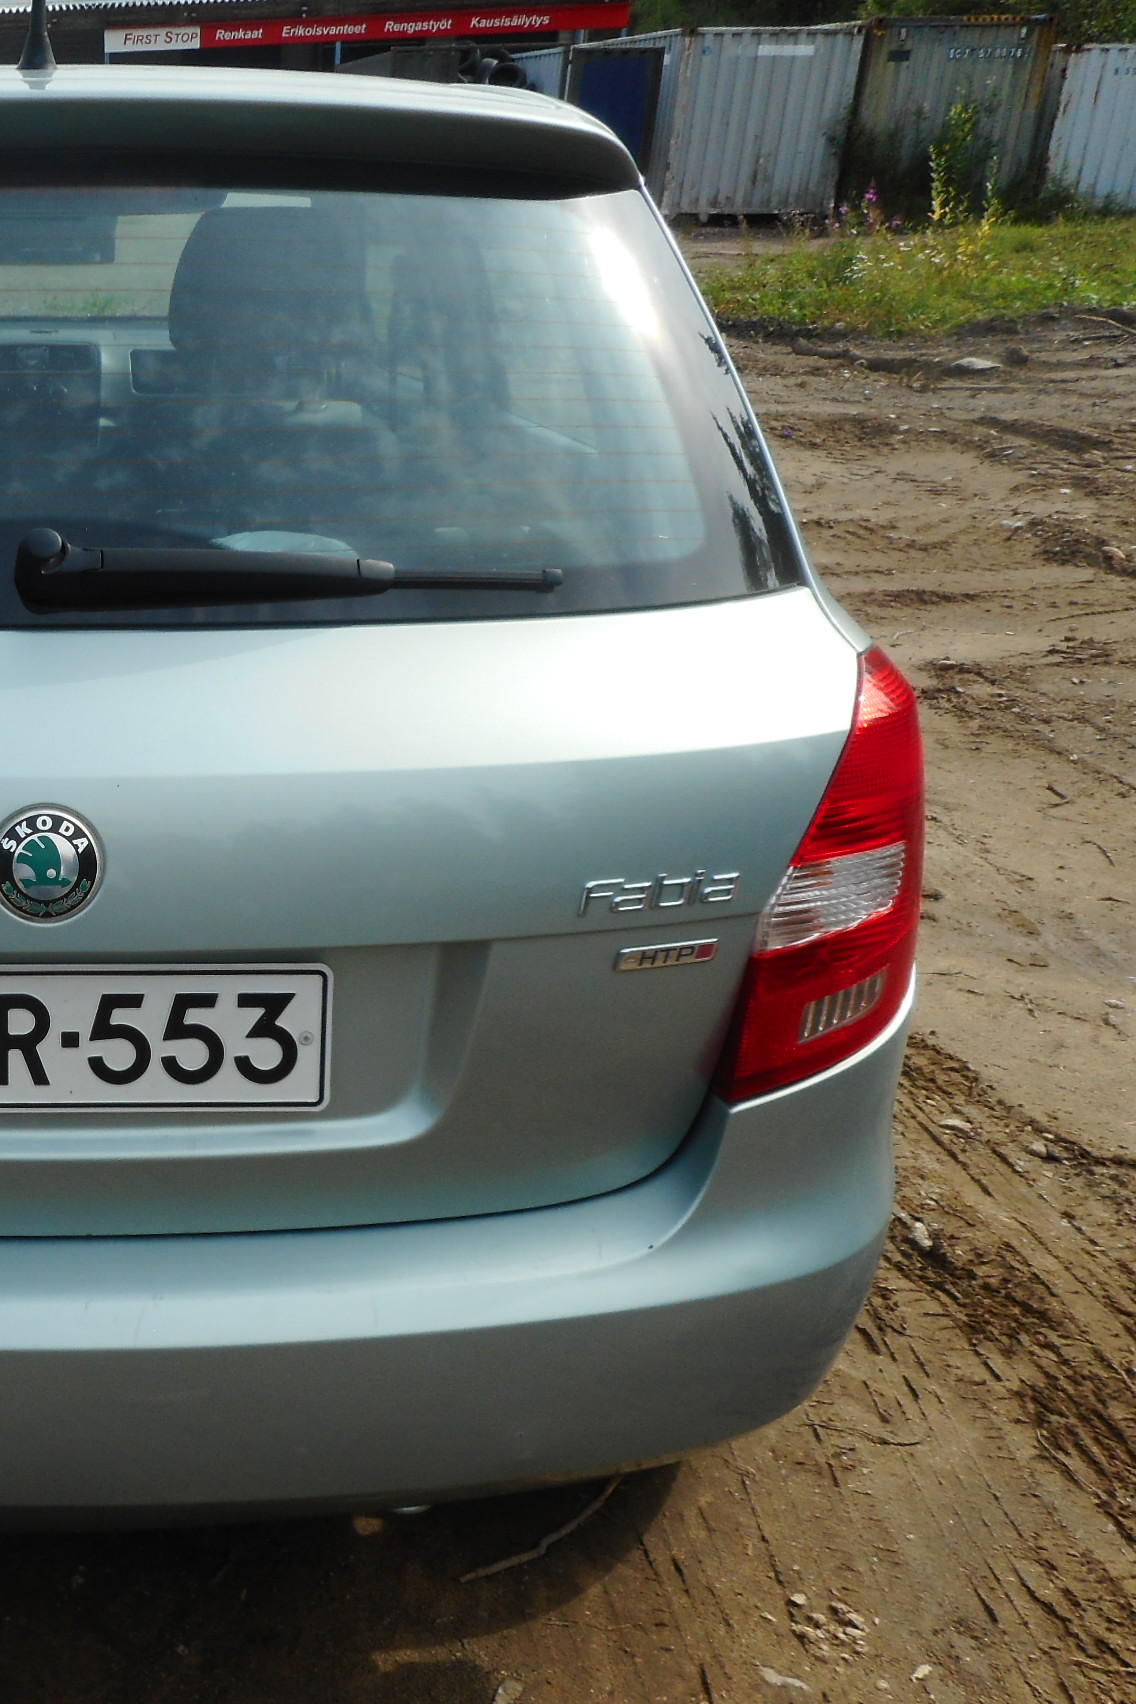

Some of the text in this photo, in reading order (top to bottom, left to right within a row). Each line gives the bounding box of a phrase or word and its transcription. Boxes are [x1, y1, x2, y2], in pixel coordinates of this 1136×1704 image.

[124, 31, 198, 46] FIRST STOP
[215, 14, 549, 40] Renkaat Erikoisvanteet Rengastyöt Kausisäilytys
[0, 815, 90, 854] ŠKODA
[577, 869, 741, 917] Fabia
